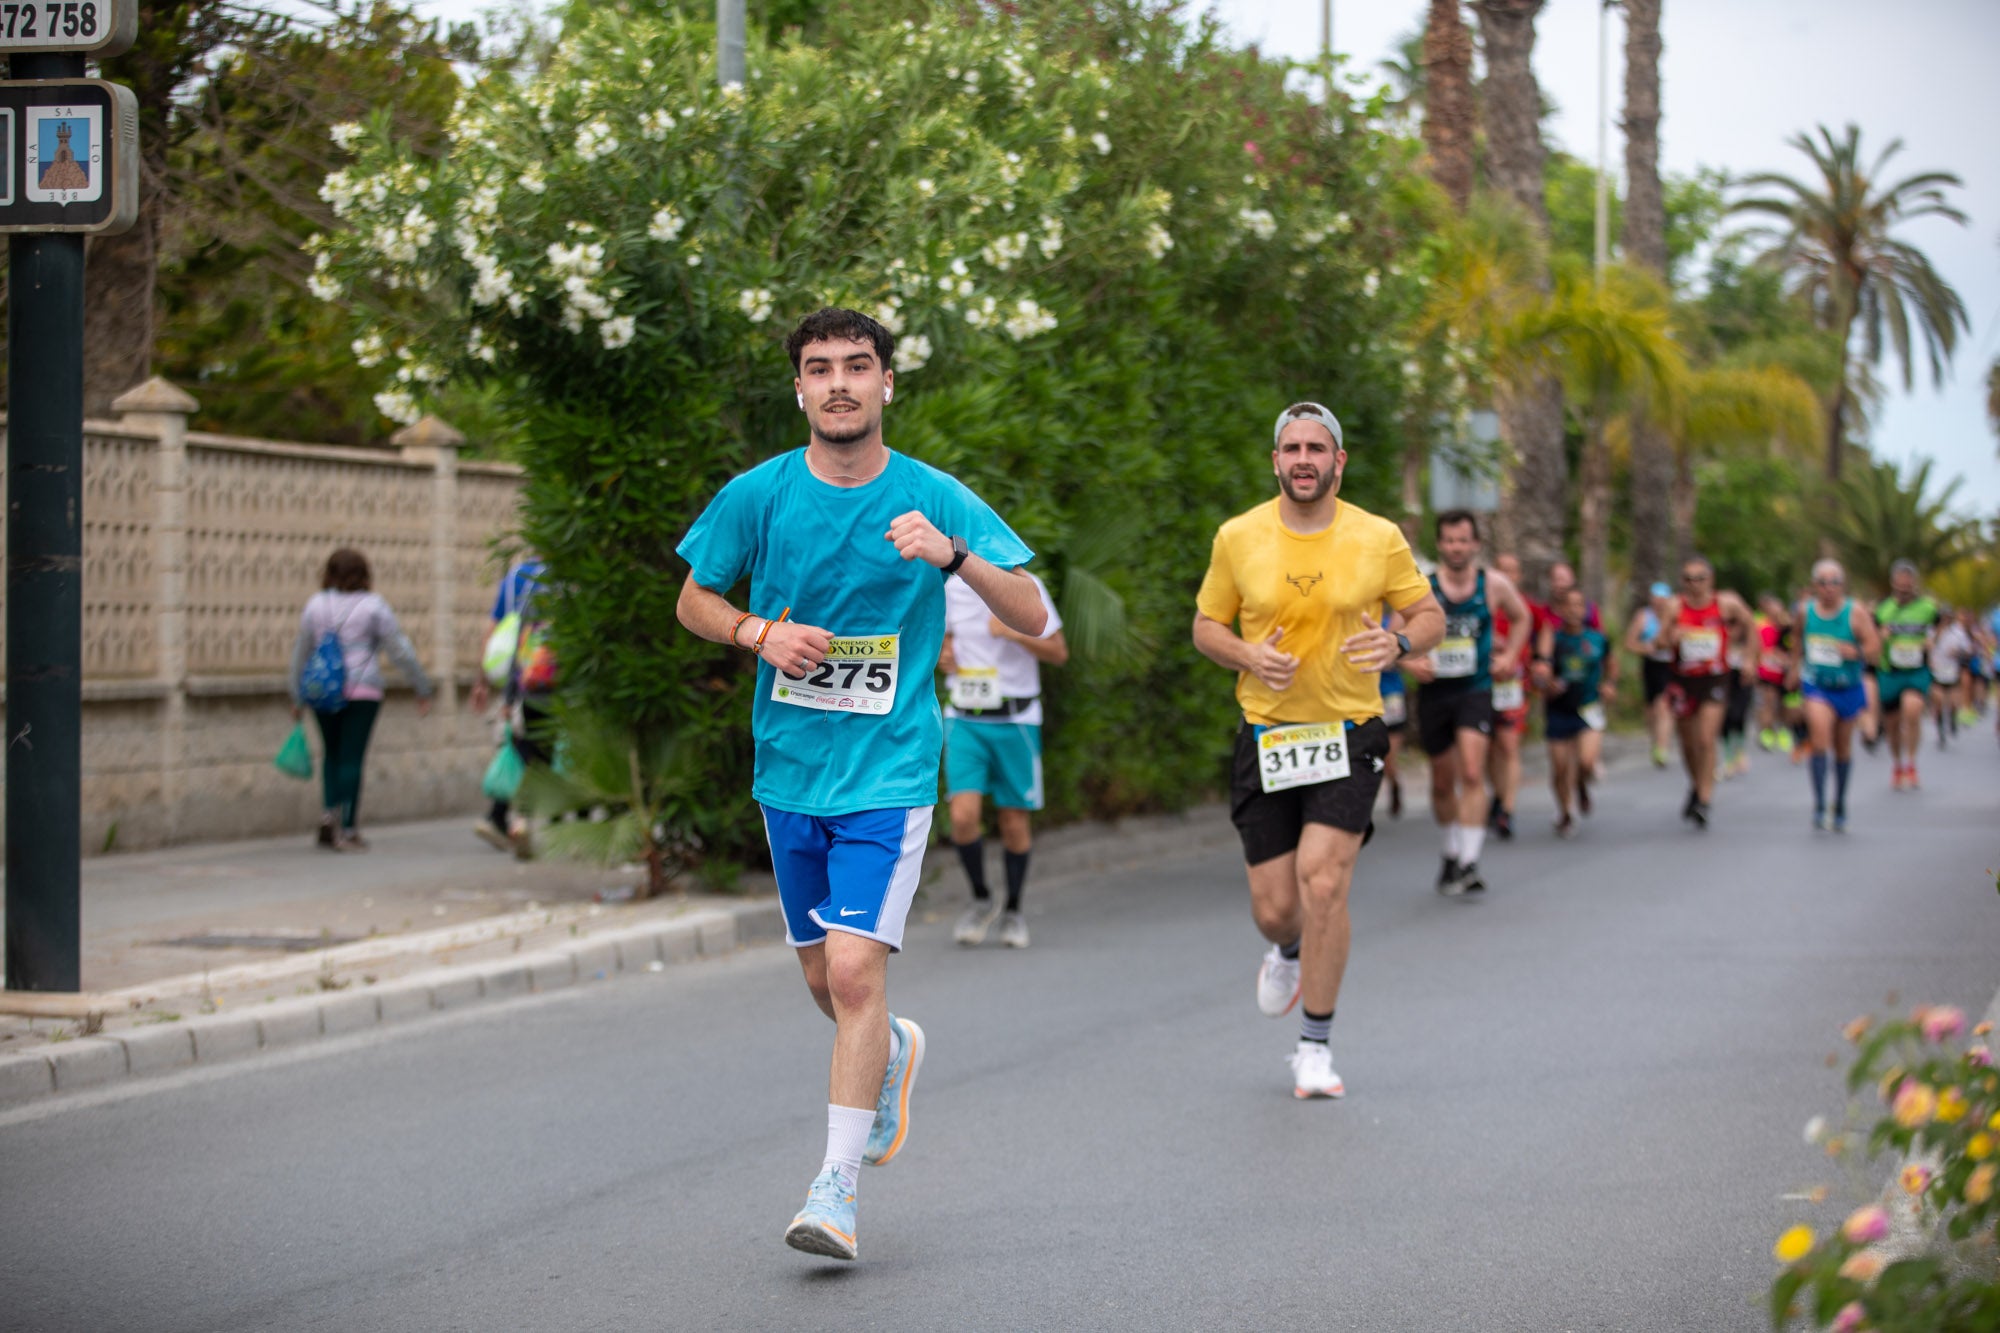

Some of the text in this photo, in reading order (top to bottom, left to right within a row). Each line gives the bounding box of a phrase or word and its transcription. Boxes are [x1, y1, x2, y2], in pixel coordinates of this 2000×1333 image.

[0, 2, 97, 38] 72 758
[55, 107, 73, 117] SA
[824, 645, 875, 656] ONDO
[1265, 742, 1342, 773] 3178
